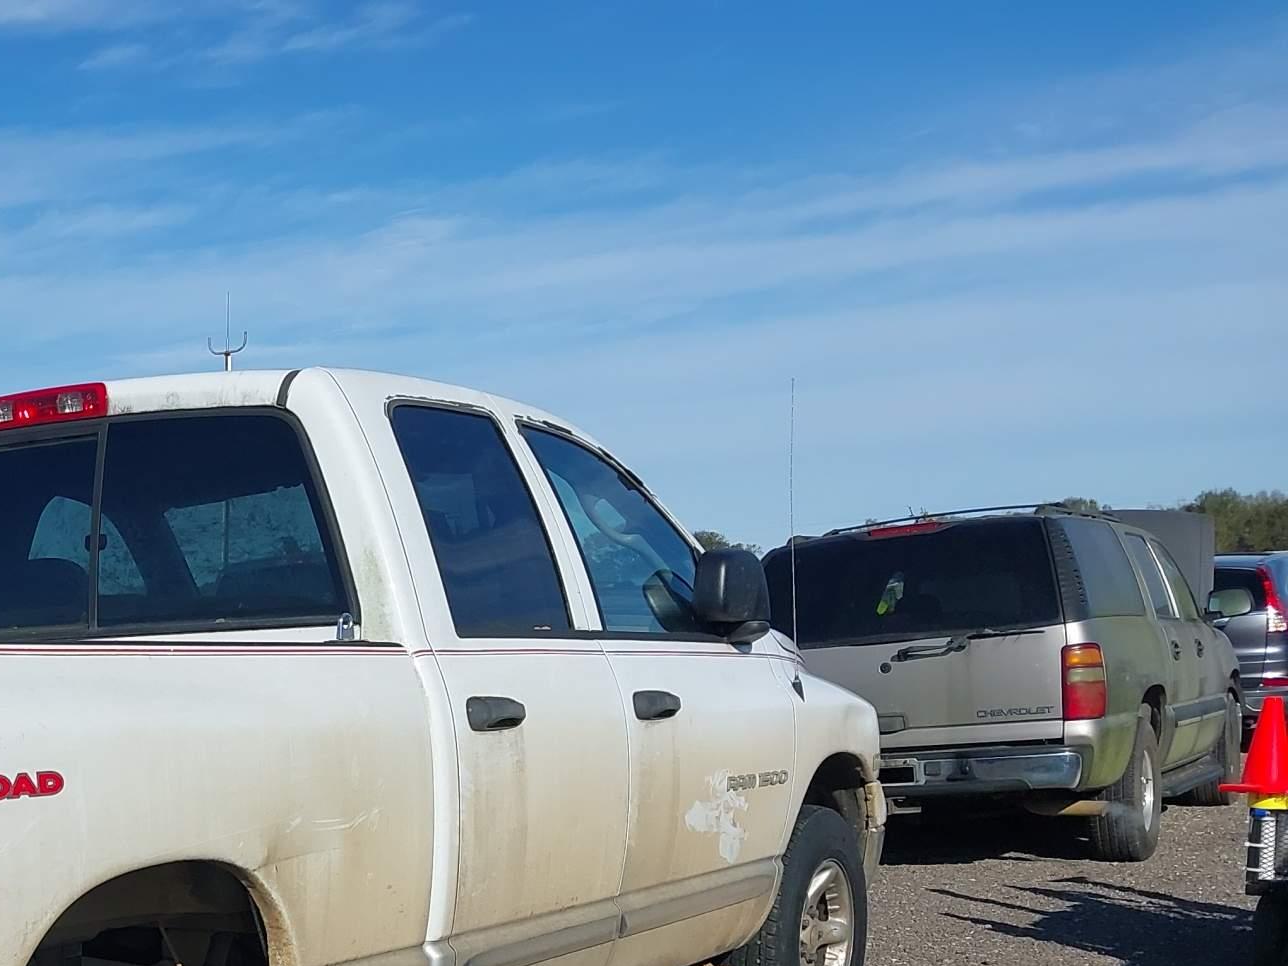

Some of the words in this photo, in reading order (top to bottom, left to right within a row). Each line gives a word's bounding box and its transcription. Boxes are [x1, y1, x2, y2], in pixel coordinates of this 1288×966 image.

[977, 706, 1054, 718] CHEVROLET
[727, 774, 757, 792] RAM
[758, 770, 788, 787] 1500
